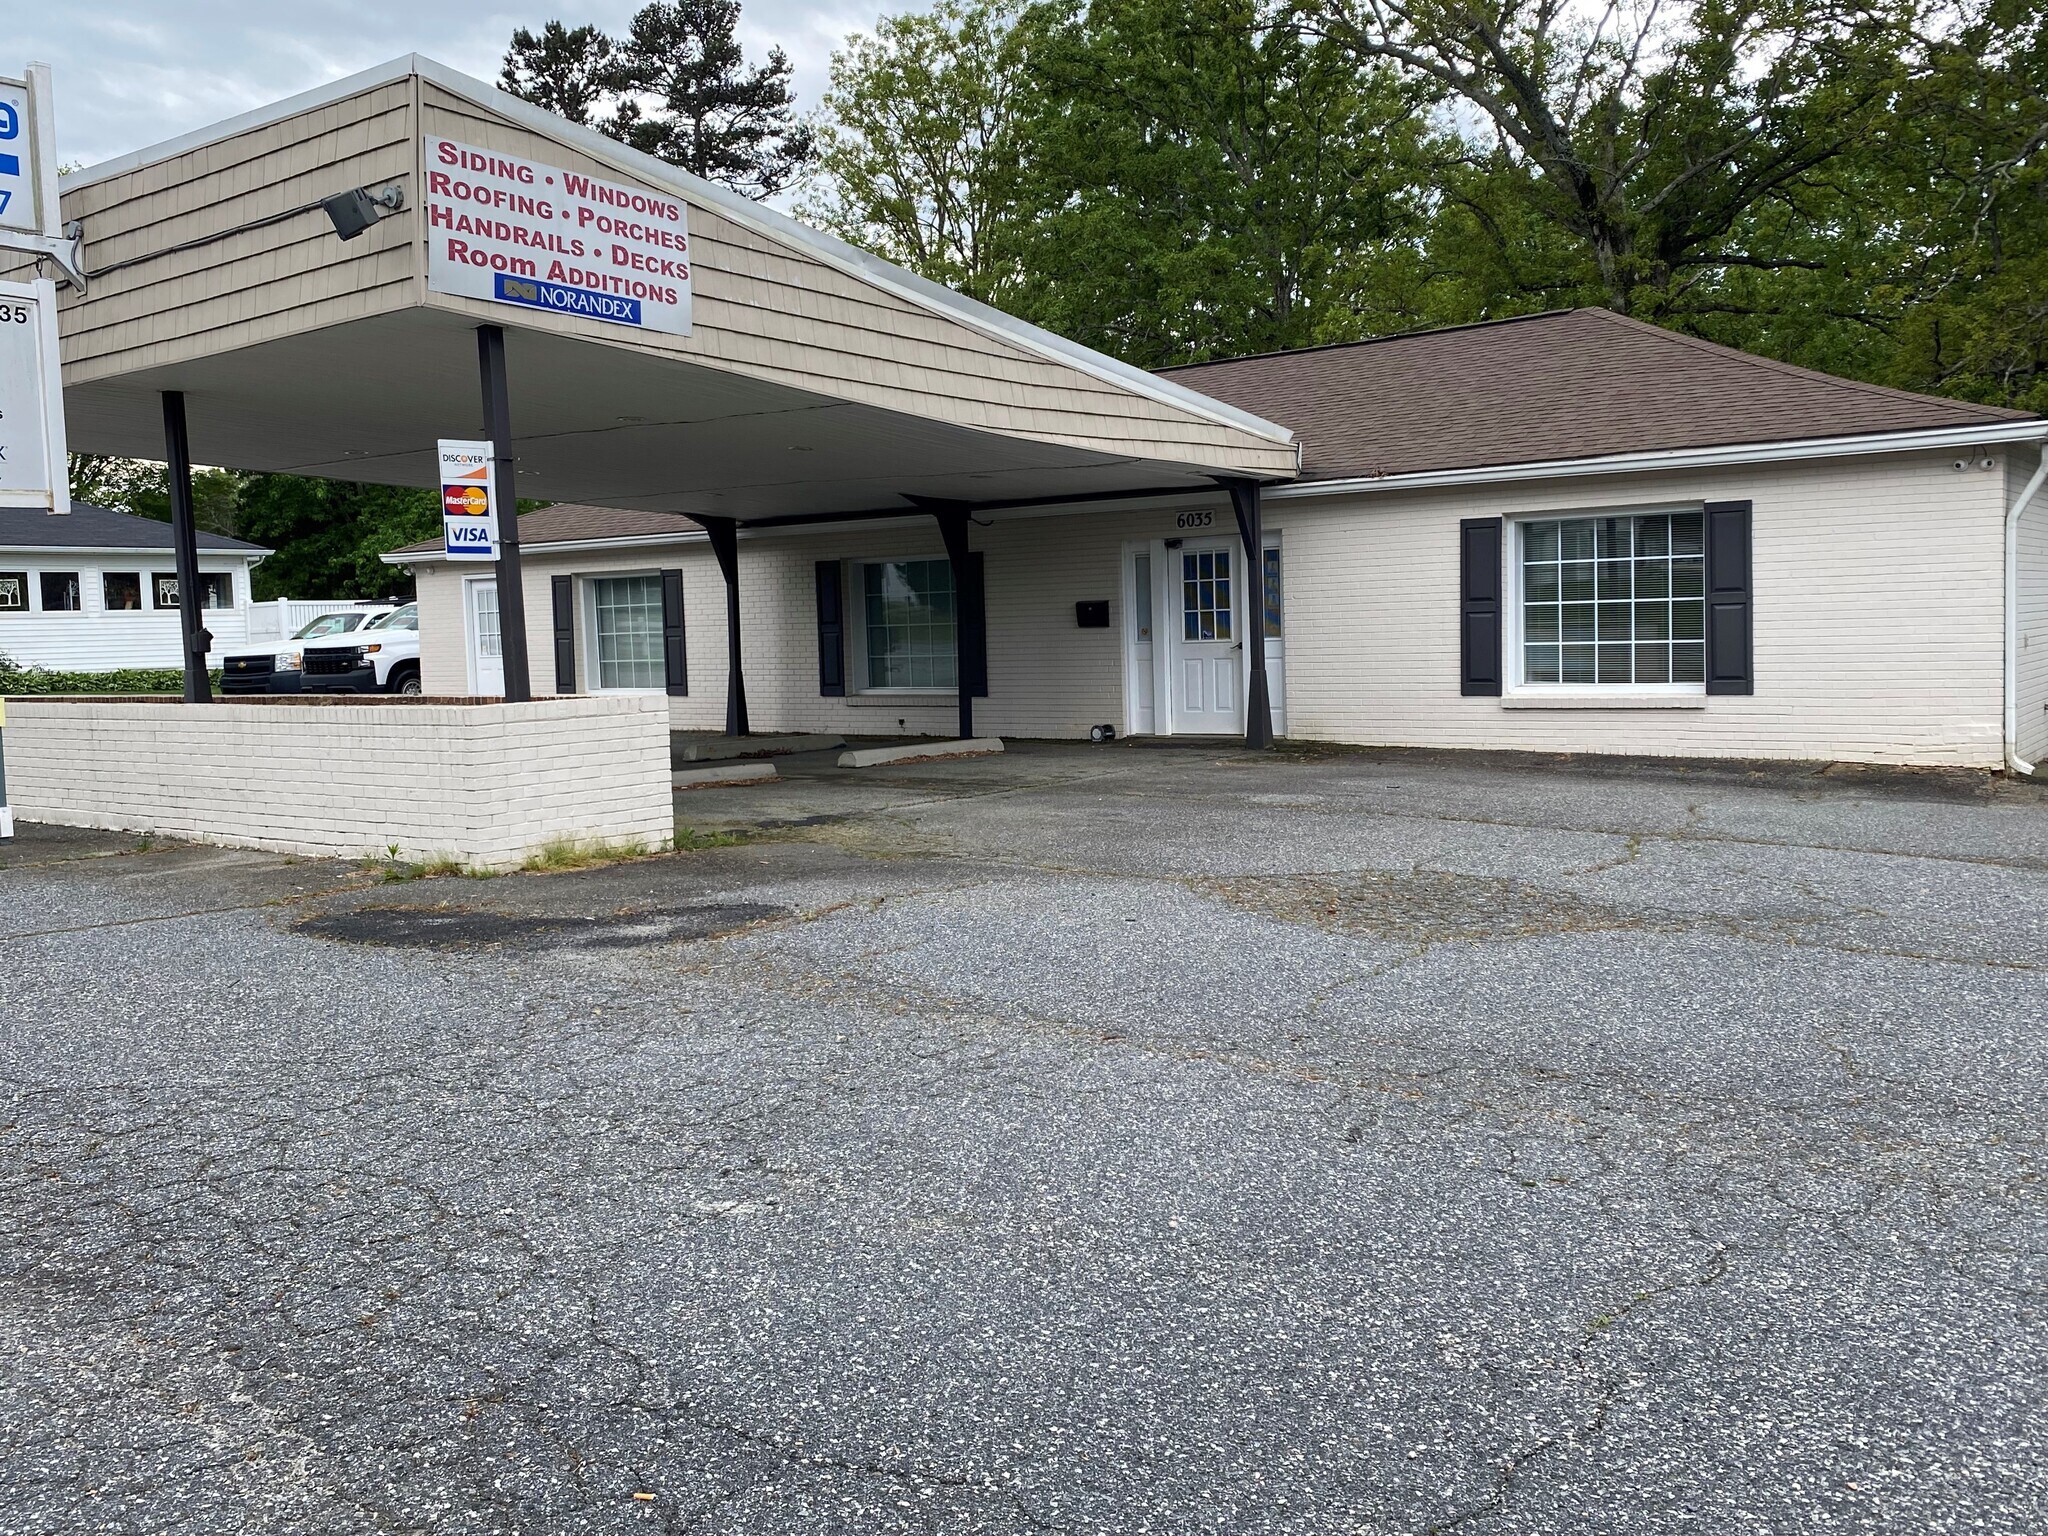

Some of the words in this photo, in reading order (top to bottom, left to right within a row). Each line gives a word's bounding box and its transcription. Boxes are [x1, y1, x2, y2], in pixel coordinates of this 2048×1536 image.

[563, 172, 679, 222] WINDOWS
[429, 171, 553, 220] ROOFING
[578, 206, 687, 252] PORCHES
[430, 203, 585, 257] HANDRAILS
[611, 244, 689, 281] DECKS
[540, 286, 633, 319] NORANDEX
[442, 454, 484, 463] DISCOVER
[445, 495, 487, 506] MasterCard
[1176, 512, 1213, 528] 6035
[451, 527, 489, 542] VISA
